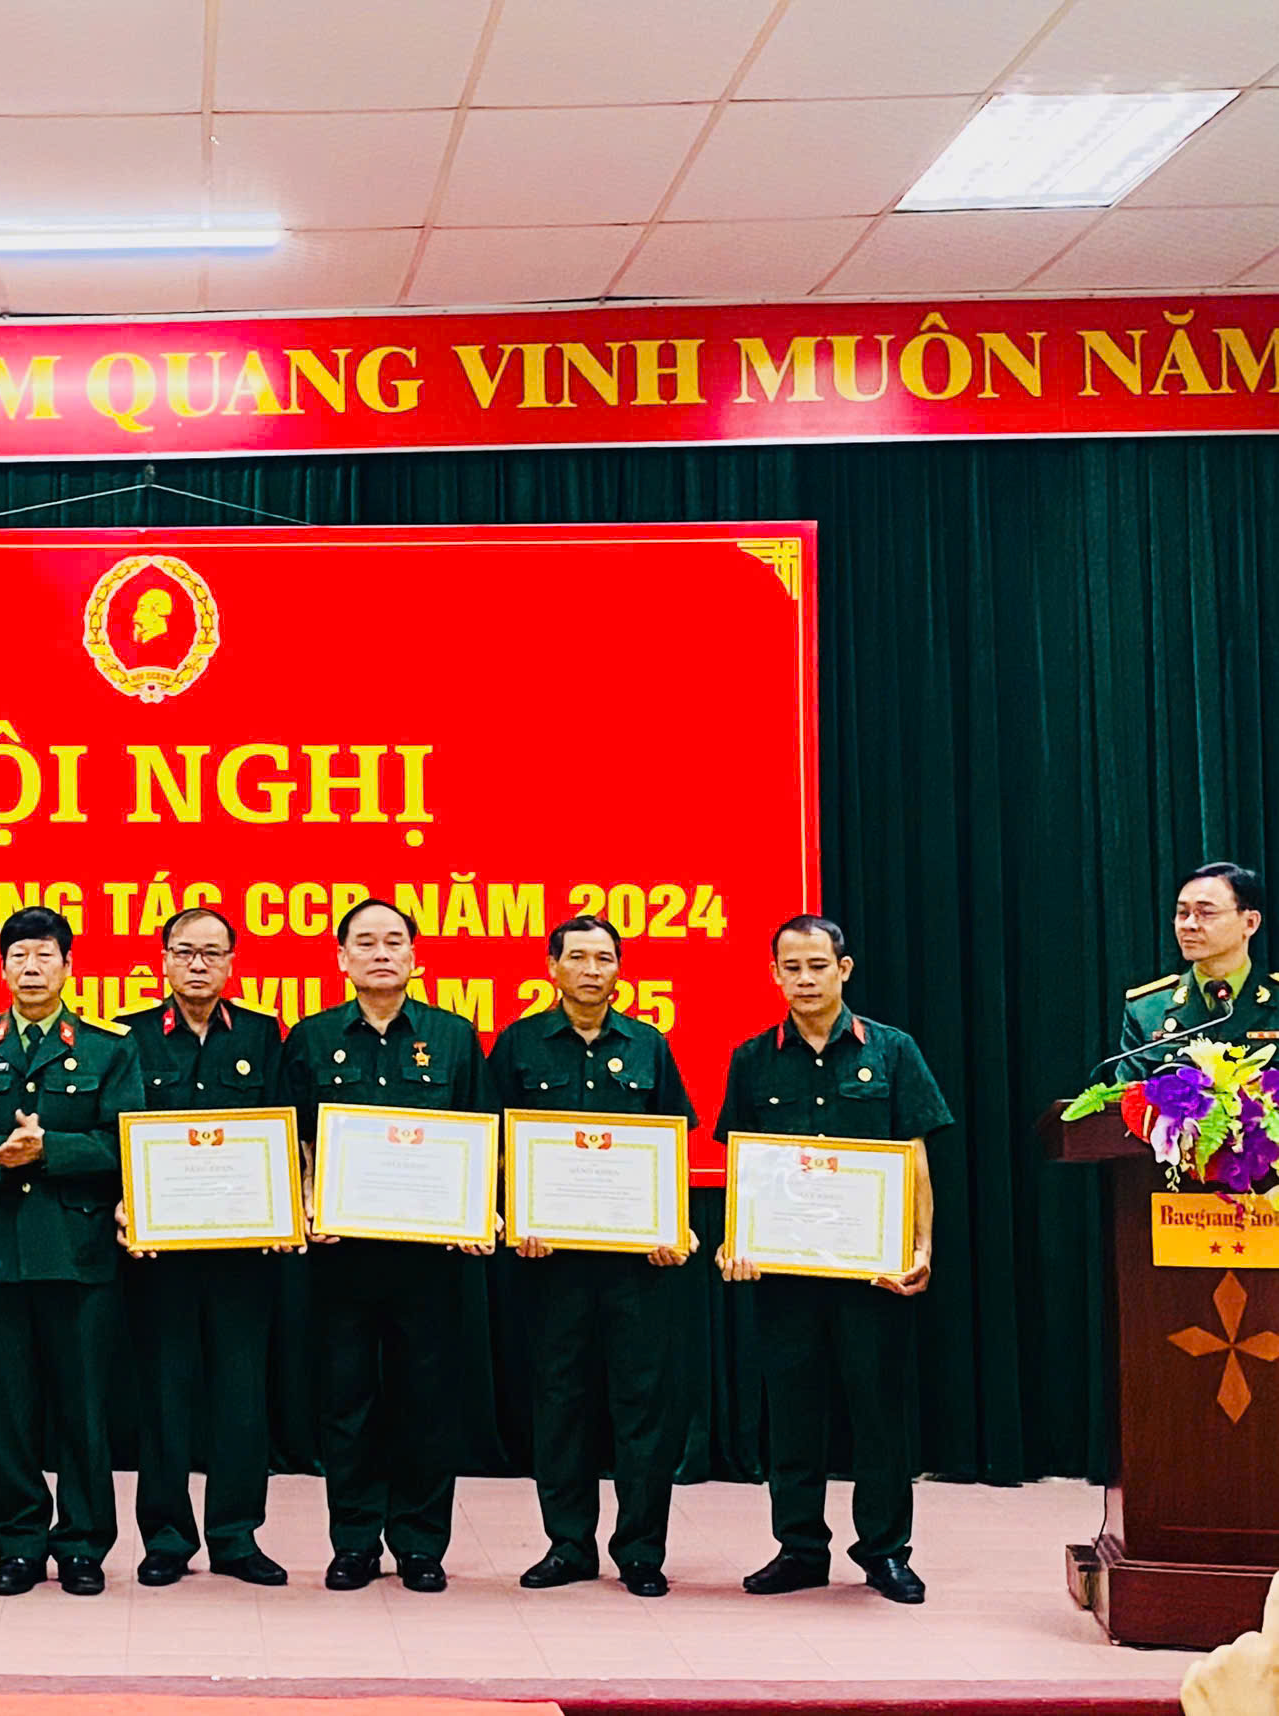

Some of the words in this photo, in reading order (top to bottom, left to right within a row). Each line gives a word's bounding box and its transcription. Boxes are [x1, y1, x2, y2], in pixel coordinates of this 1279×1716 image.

[85, 346, 425, 433] QUANG
[452, 338, 706, 409] VINH
[733, 311, 1048, 404] MUÔN
[1076, 309, 1279, 396] NĂM
[126, 743, 433, 847] NGHỊ
[394, 871, 546, 937] NĂM
[569, 883, 727, 938] 2024
